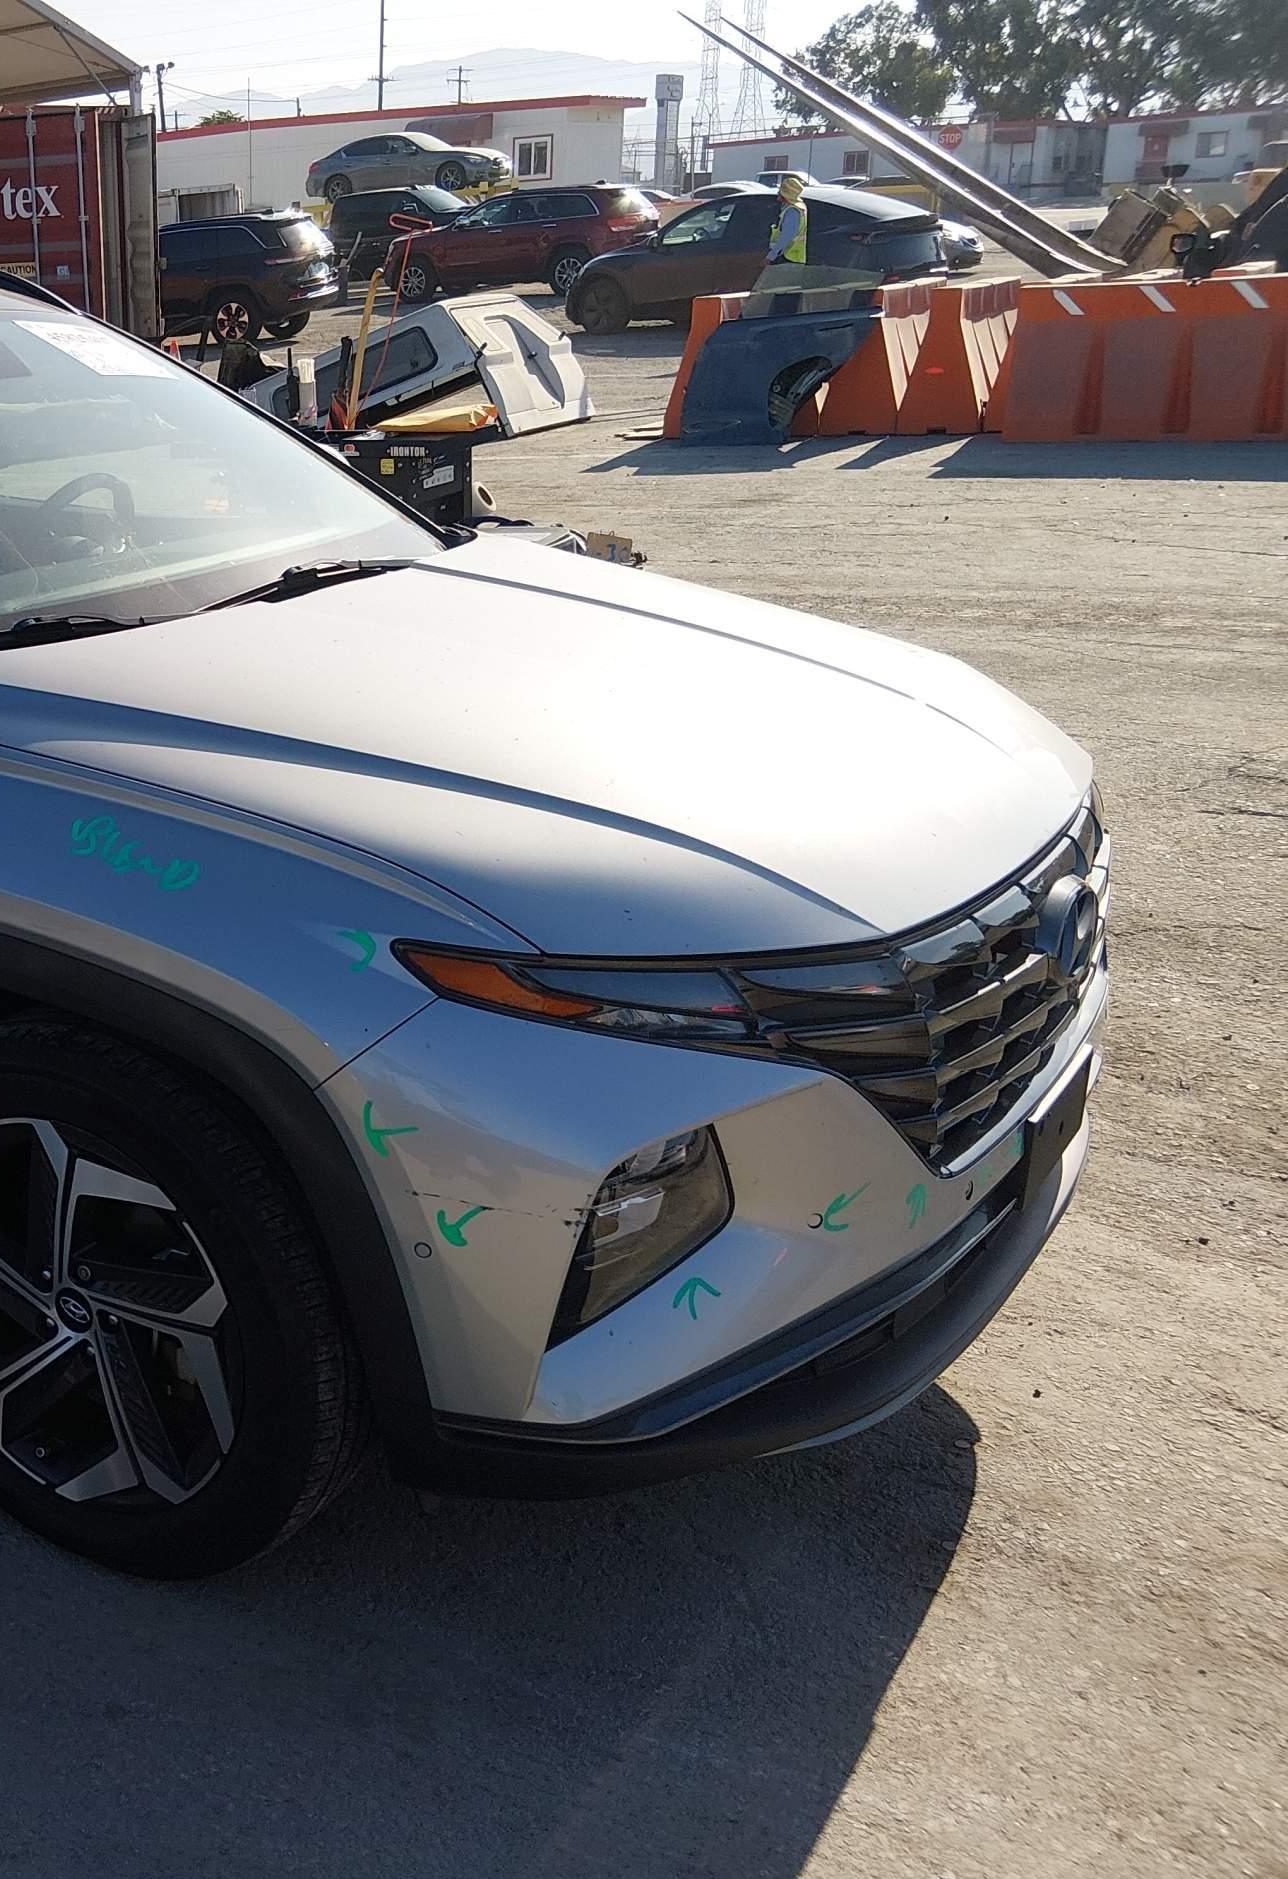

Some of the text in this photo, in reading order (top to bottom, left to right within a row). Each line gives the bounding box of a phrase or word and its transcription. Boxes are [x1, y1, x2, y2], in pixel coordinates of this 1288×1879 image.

[939, 132, 961, 144] STOP
[0, 176, 62, 220] tex
[390, 446, 426, 457] IRONTON
